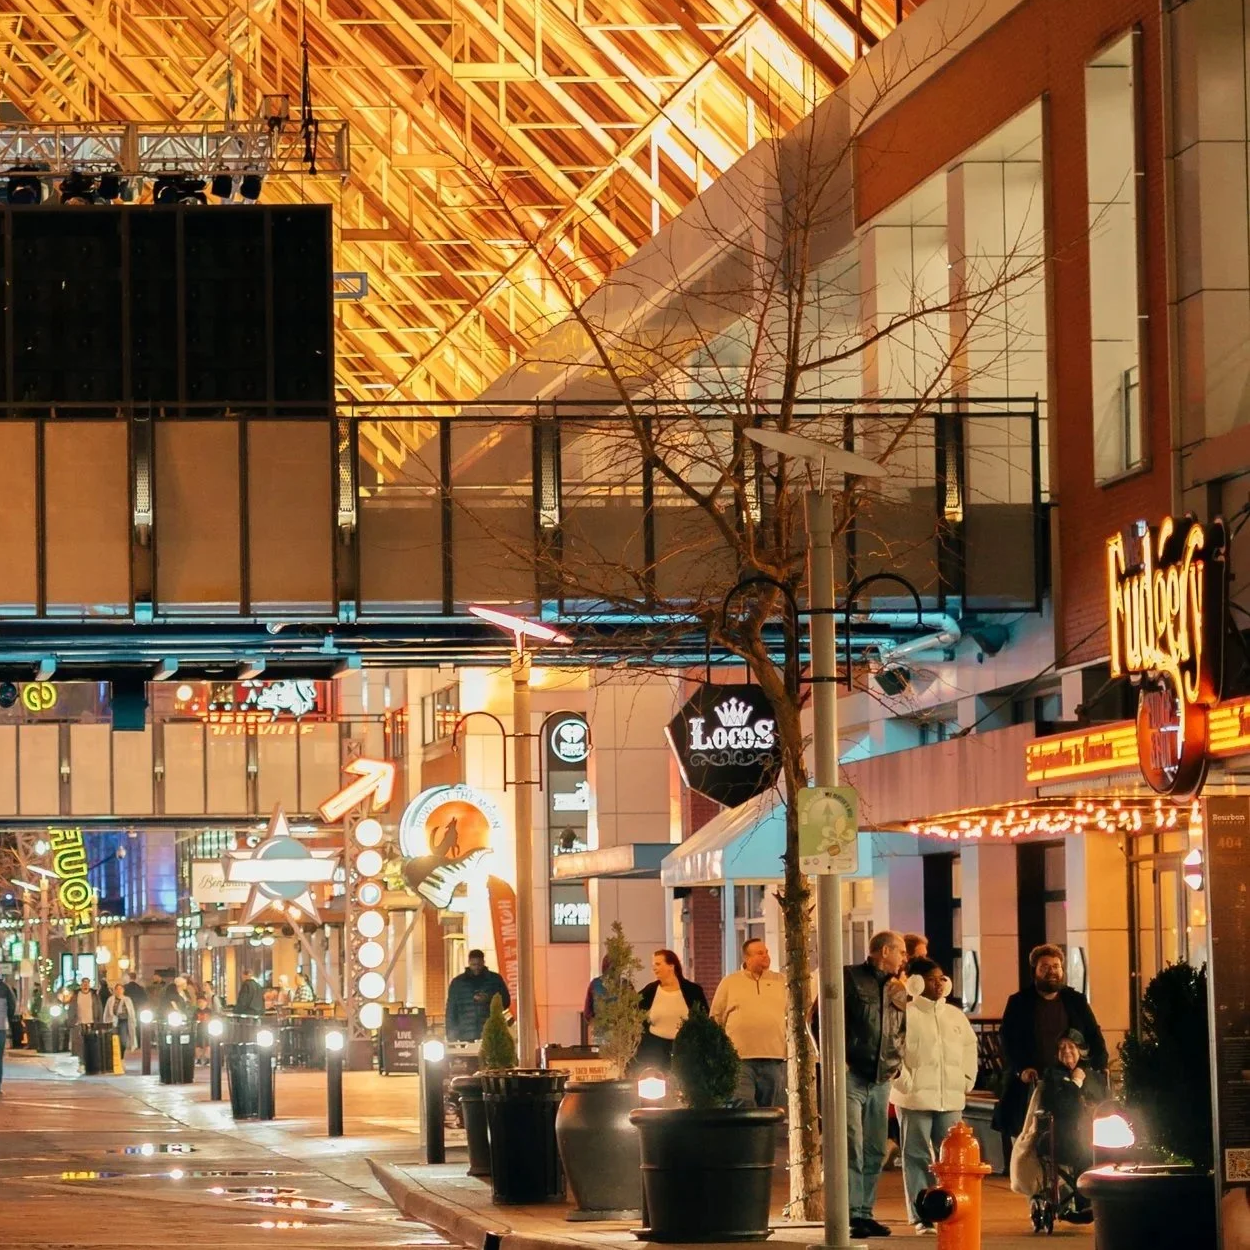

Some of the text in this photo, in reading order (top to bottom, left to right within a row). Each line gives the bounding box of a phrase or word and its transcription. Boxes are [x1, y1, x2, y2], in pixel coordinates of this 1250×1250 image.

[1106, 516, 1204, 703] Fudgery
[1212, 813, 1246, 821] Bourbon
[1216, 837, 1242, 848] 404
[397, 1031, 412, 1040] LIVE
[393, 1040, 416, 1049] MUSIC
